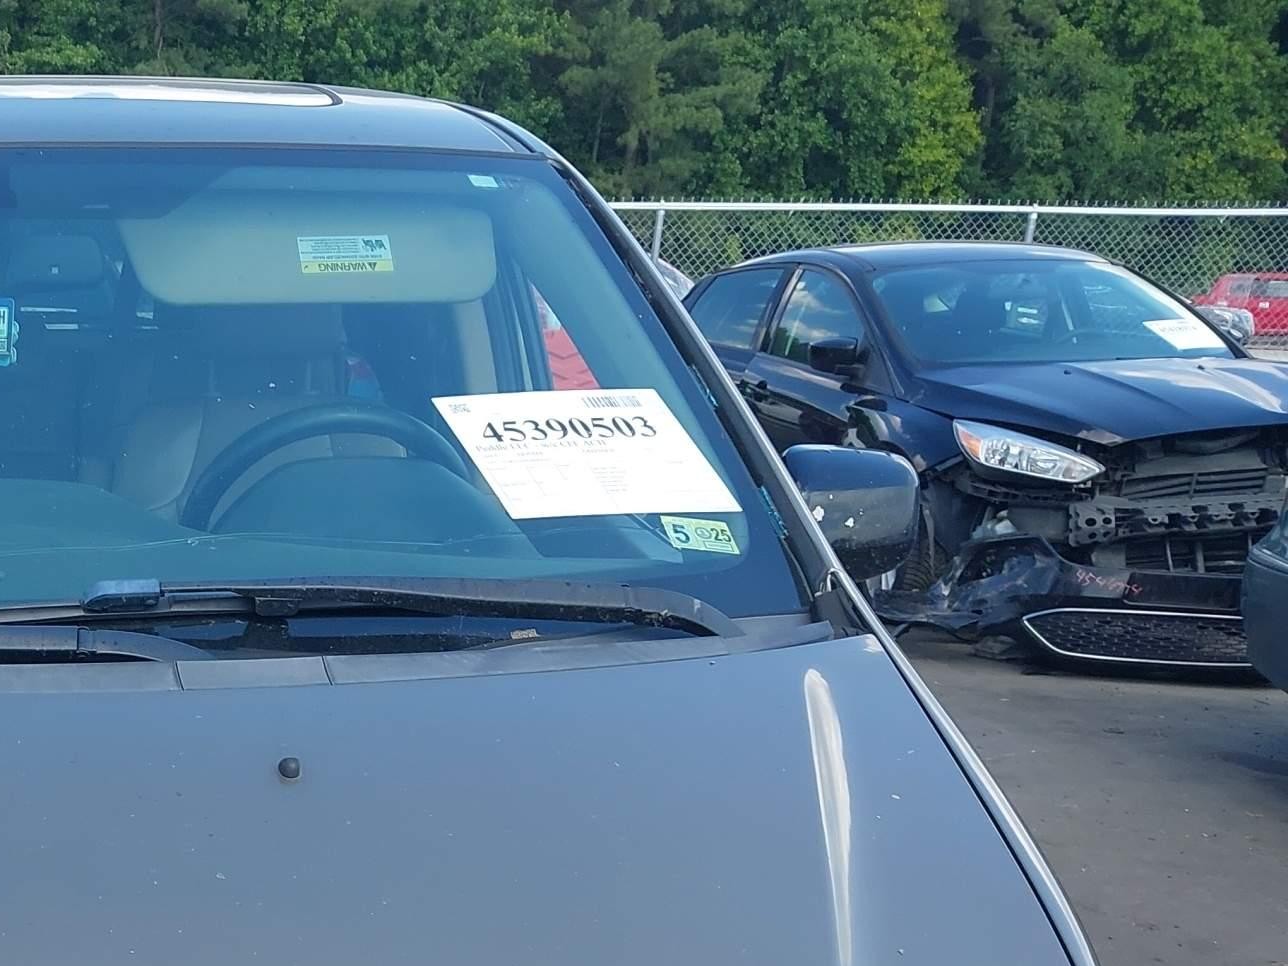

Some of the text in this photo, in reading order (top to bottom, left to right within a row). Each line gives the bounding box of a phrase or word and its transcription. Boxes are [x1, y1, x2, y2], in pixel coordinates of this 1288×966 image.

[318, 262, 368, 272] WARNING
[482, 416, 657, 442] 45390503
[672, 523, 732, 544] 5 25
